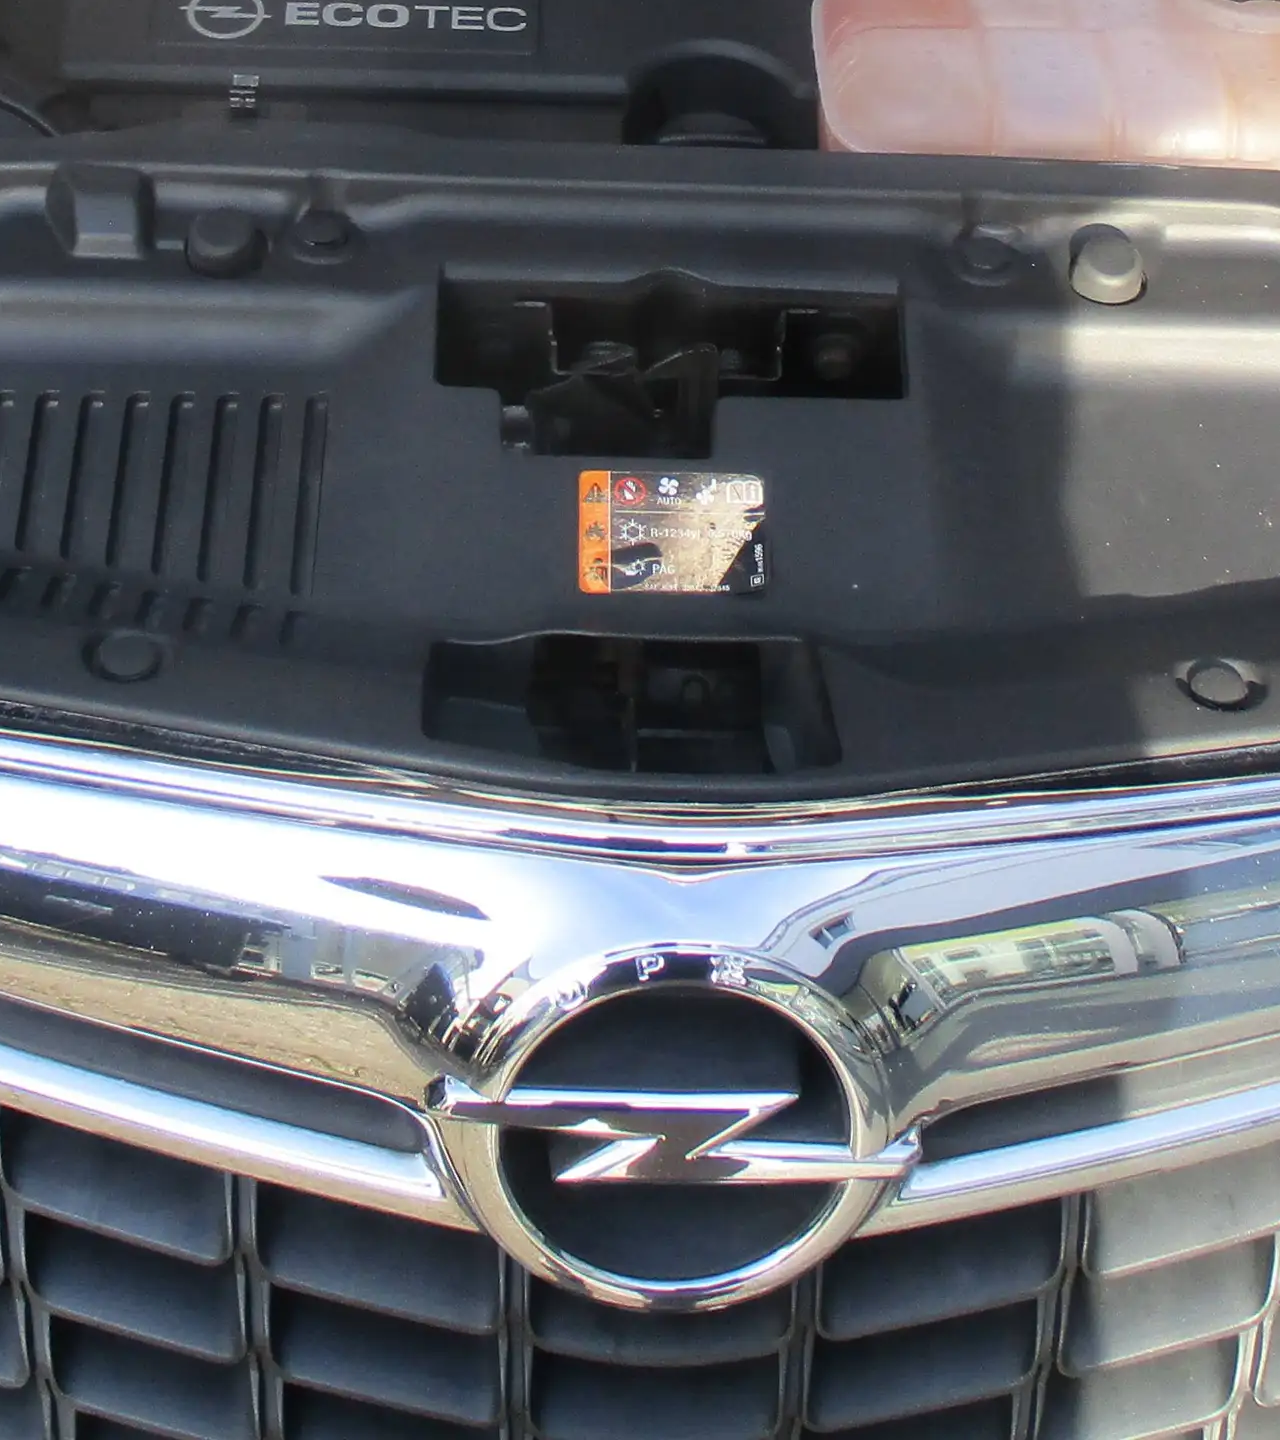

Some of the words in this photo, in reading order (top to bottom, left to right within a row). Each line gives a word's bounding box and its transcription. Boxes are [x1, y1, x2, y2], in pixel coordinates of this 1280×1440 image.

[284, 1, 527, 32] ECOTEC
[656, 496, 682, 506] AUTO
[651, 563, 676, 575] PAG
